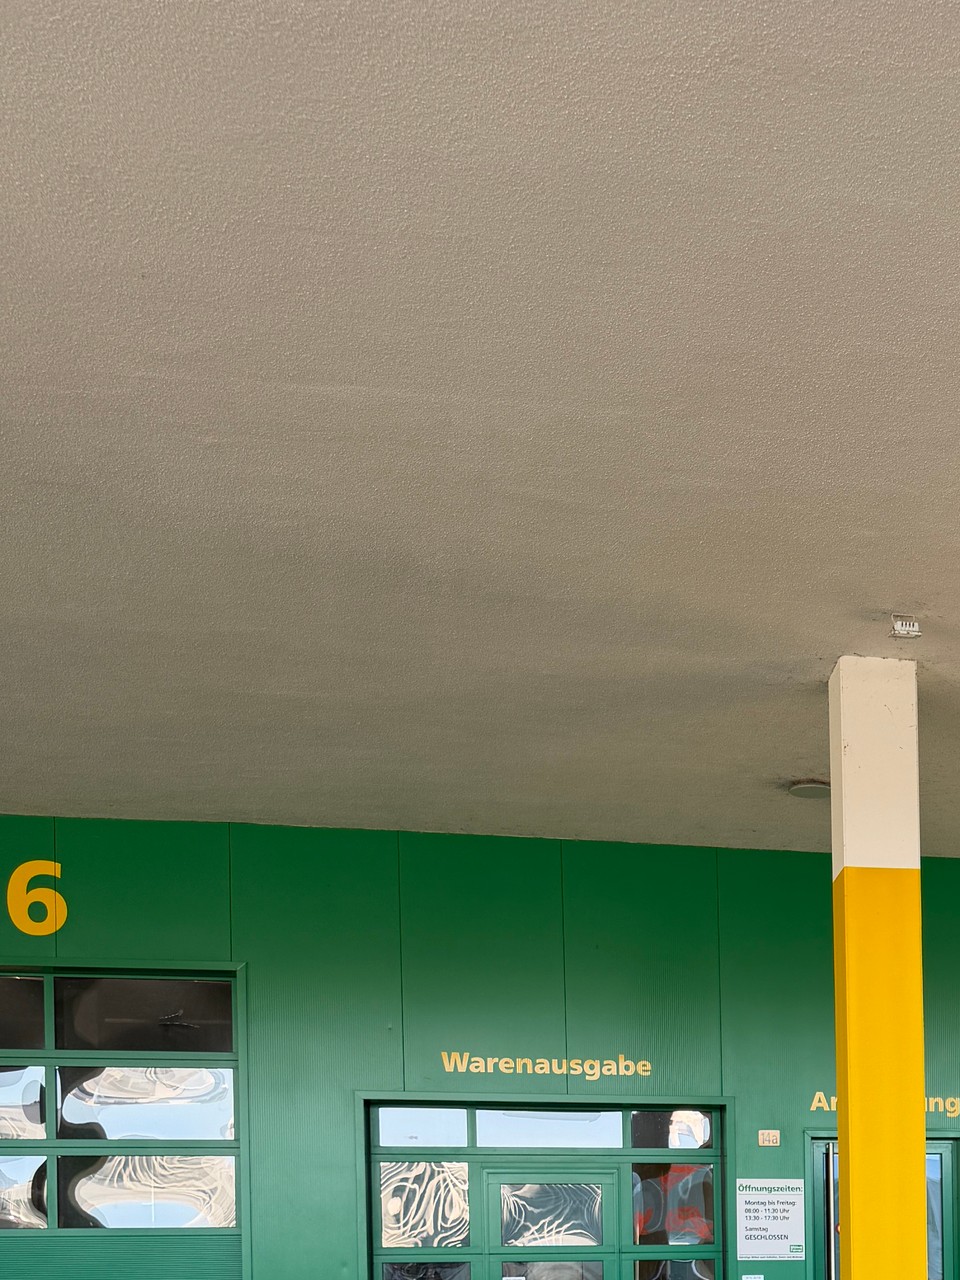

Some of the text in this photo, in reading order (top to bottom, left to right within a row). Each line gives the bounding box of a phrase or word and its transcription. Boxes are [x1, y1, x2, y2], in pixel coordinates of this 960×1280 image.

[7, 860, 68, 936] 6
[441, 1052, 652, 1081] Warenausgabe
[761, 1132, 778, 1144] 14a
[738, 1184, 803, 1193] Öffnungszeiten:
